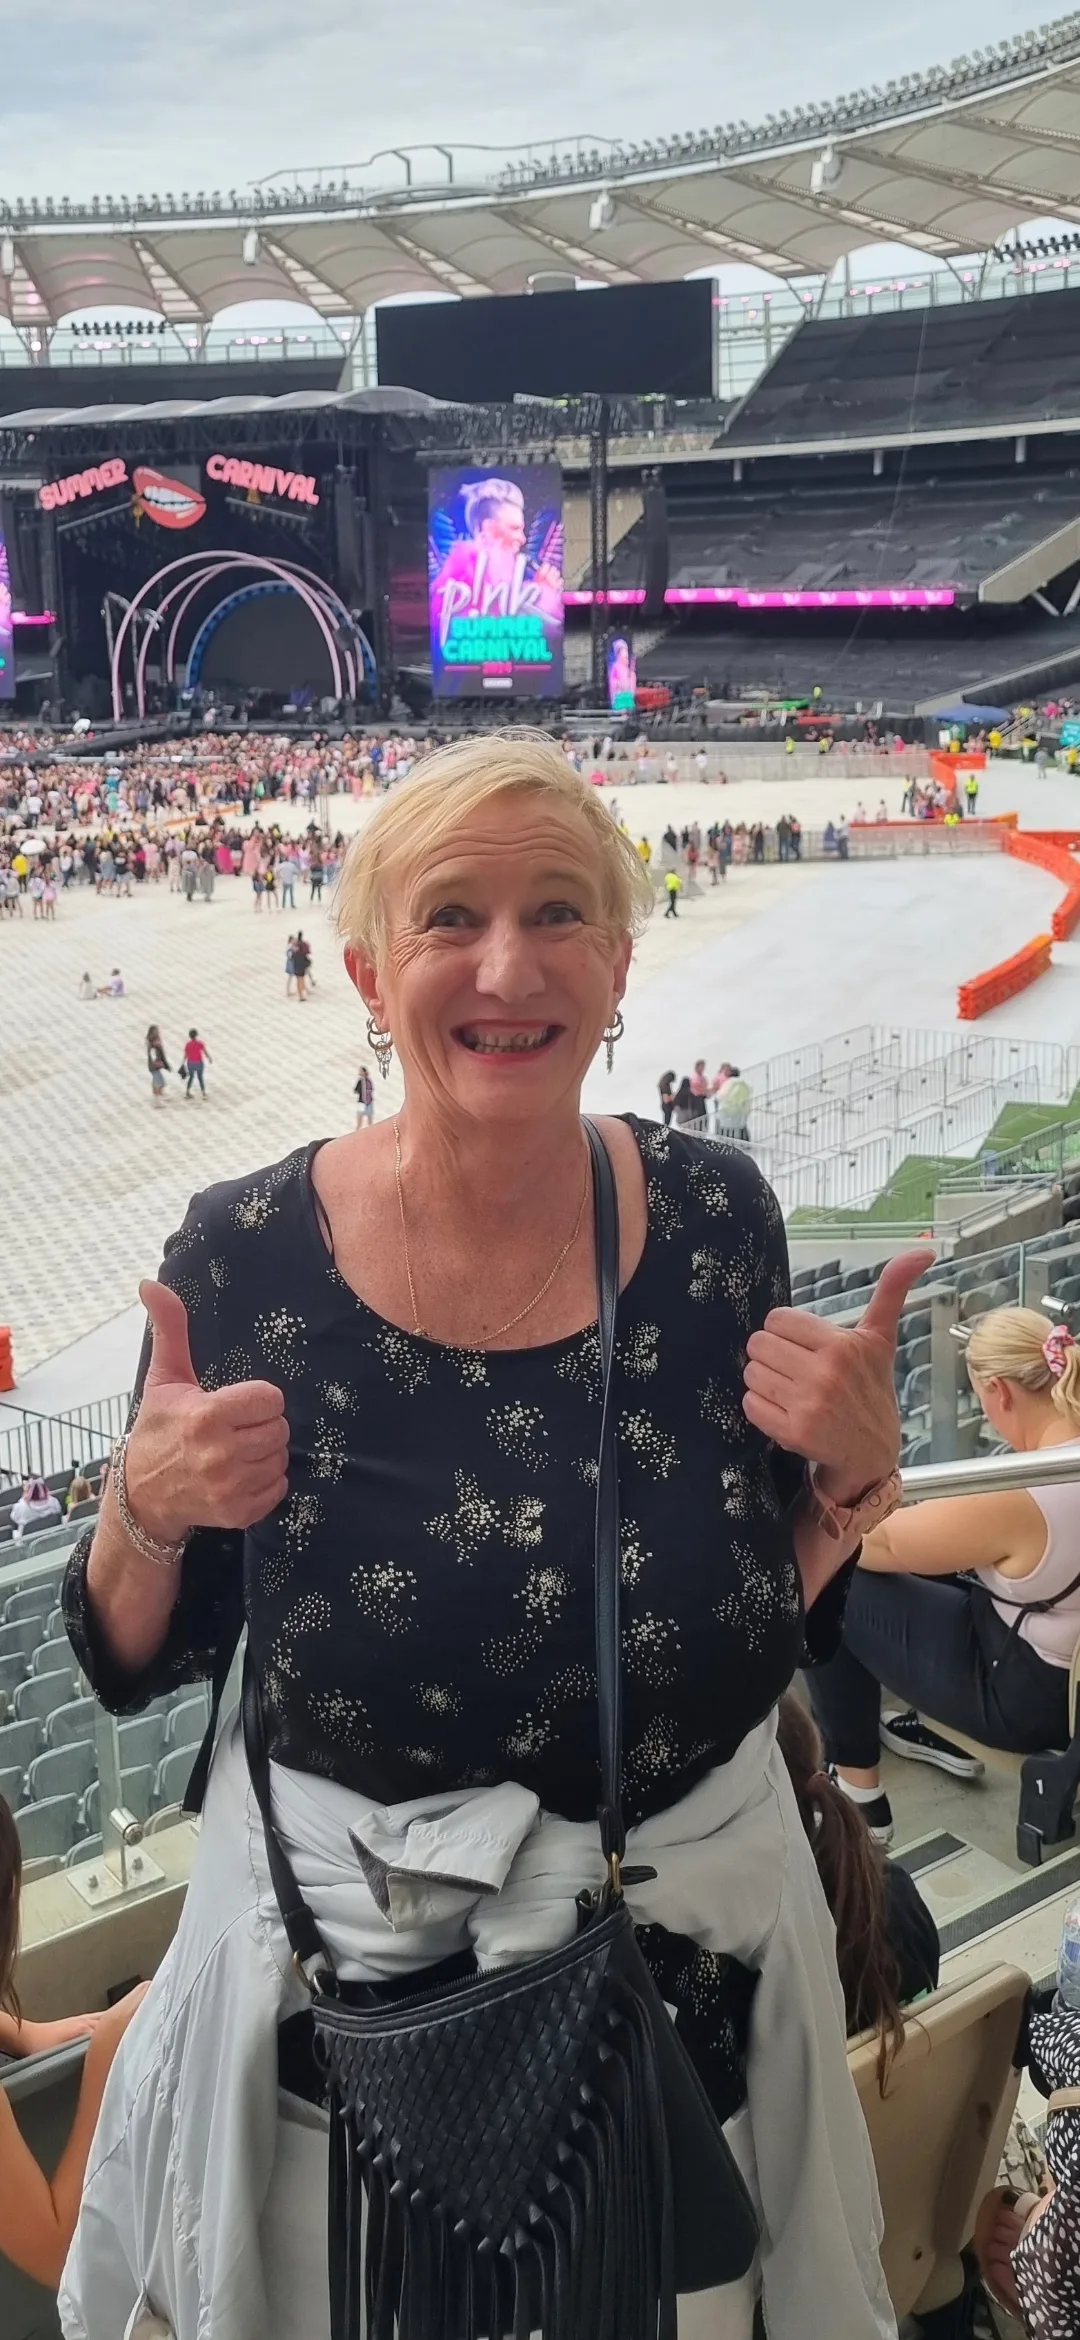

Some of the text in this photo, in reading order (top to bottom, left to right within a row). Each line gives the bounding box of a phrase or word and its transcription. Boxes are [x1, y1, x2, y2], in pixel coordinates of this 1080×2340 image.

[40, 454, 320, 510] SUMMER CARNIVAL
[450, 615, 544, 638] SUMMER
[443, 639, 554, 662] CARNIVAL
[1036, 1779, 1043, 1795] 1
